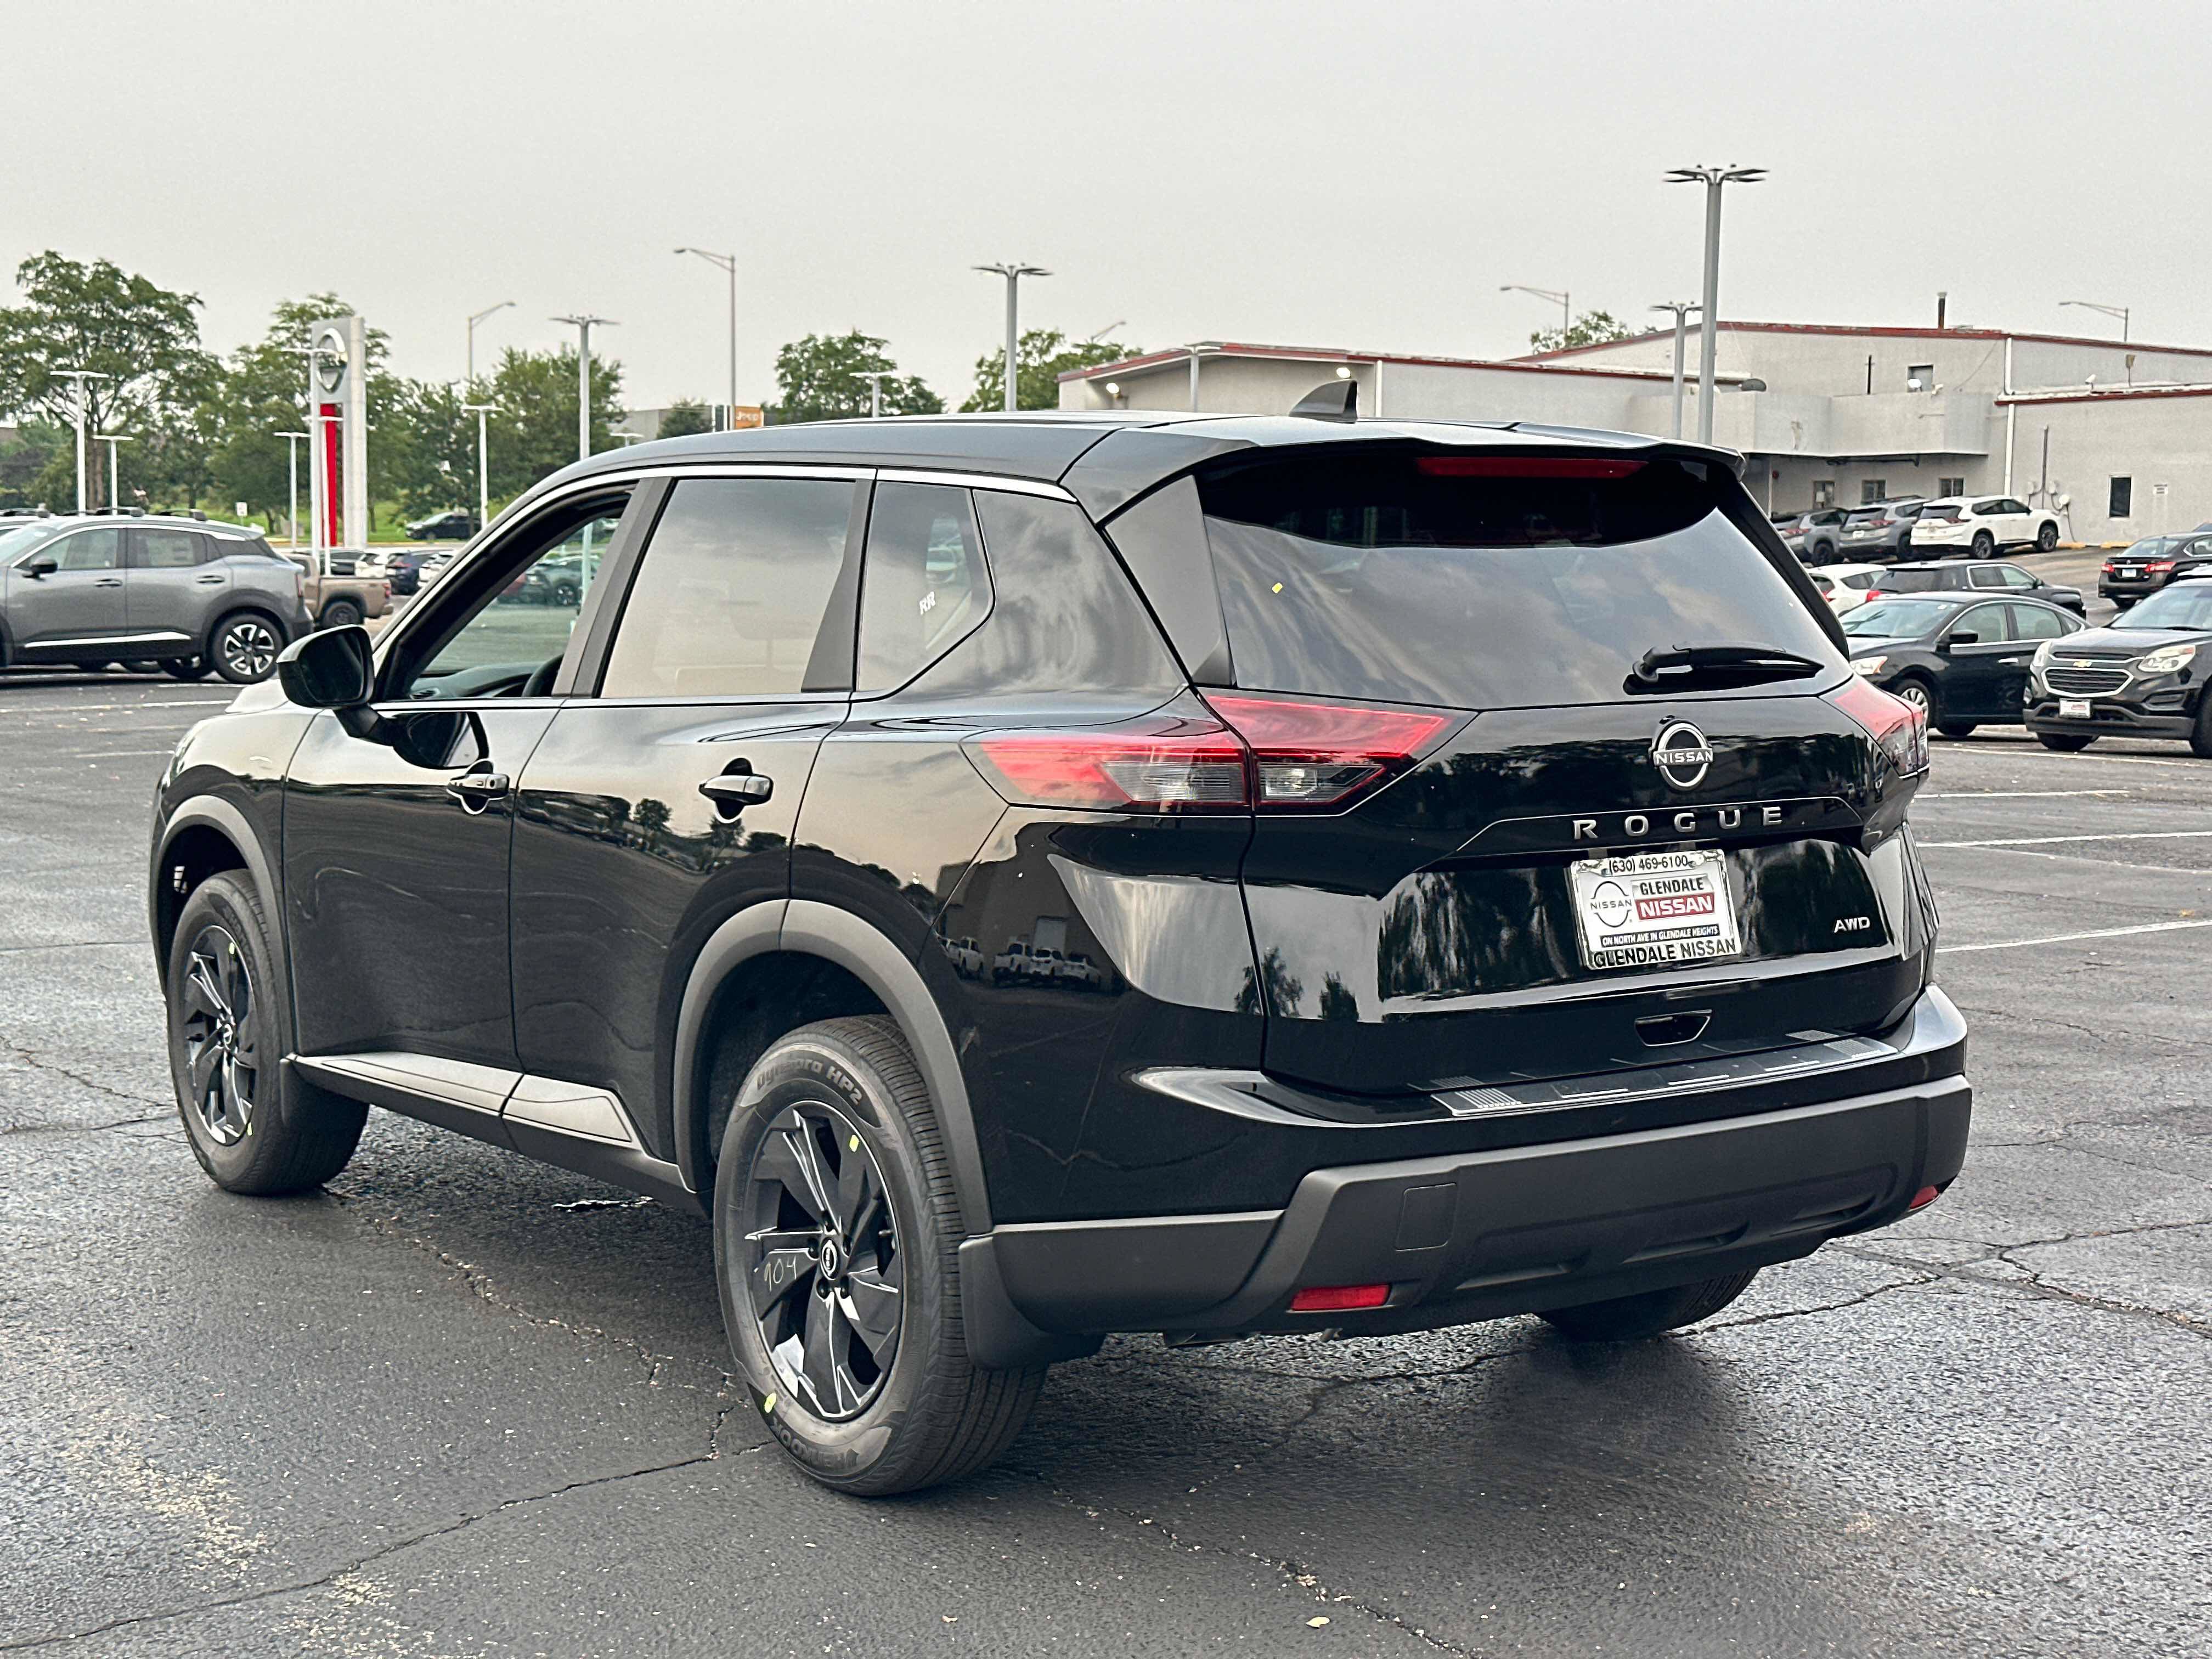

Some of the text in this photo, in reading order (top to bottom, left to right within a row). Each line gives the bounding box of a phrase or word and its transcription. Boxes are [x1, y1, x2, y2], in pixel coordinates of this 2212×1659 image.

[1655, 750, 1713, 765] NISSAN
[1573, 806, 1782, 840] ROGUE
[1609, 855, 1688, 876] (630) 469-6100
[1640, 877, 1705, 896] GLENDALE
[1590, 899, 1633, 910] NISSAN
[1640, 895, 1713, 917] NISSAN
[1834, 917, 1870, 934] AWD
[1602, 926, 1718, 946] ON NORTH AVE IN GLENDALE HEIGHTS
[1593, 938, 1737, 968] GLENDALE NISSAN
[826, 1065, 863, 1105] HP2
